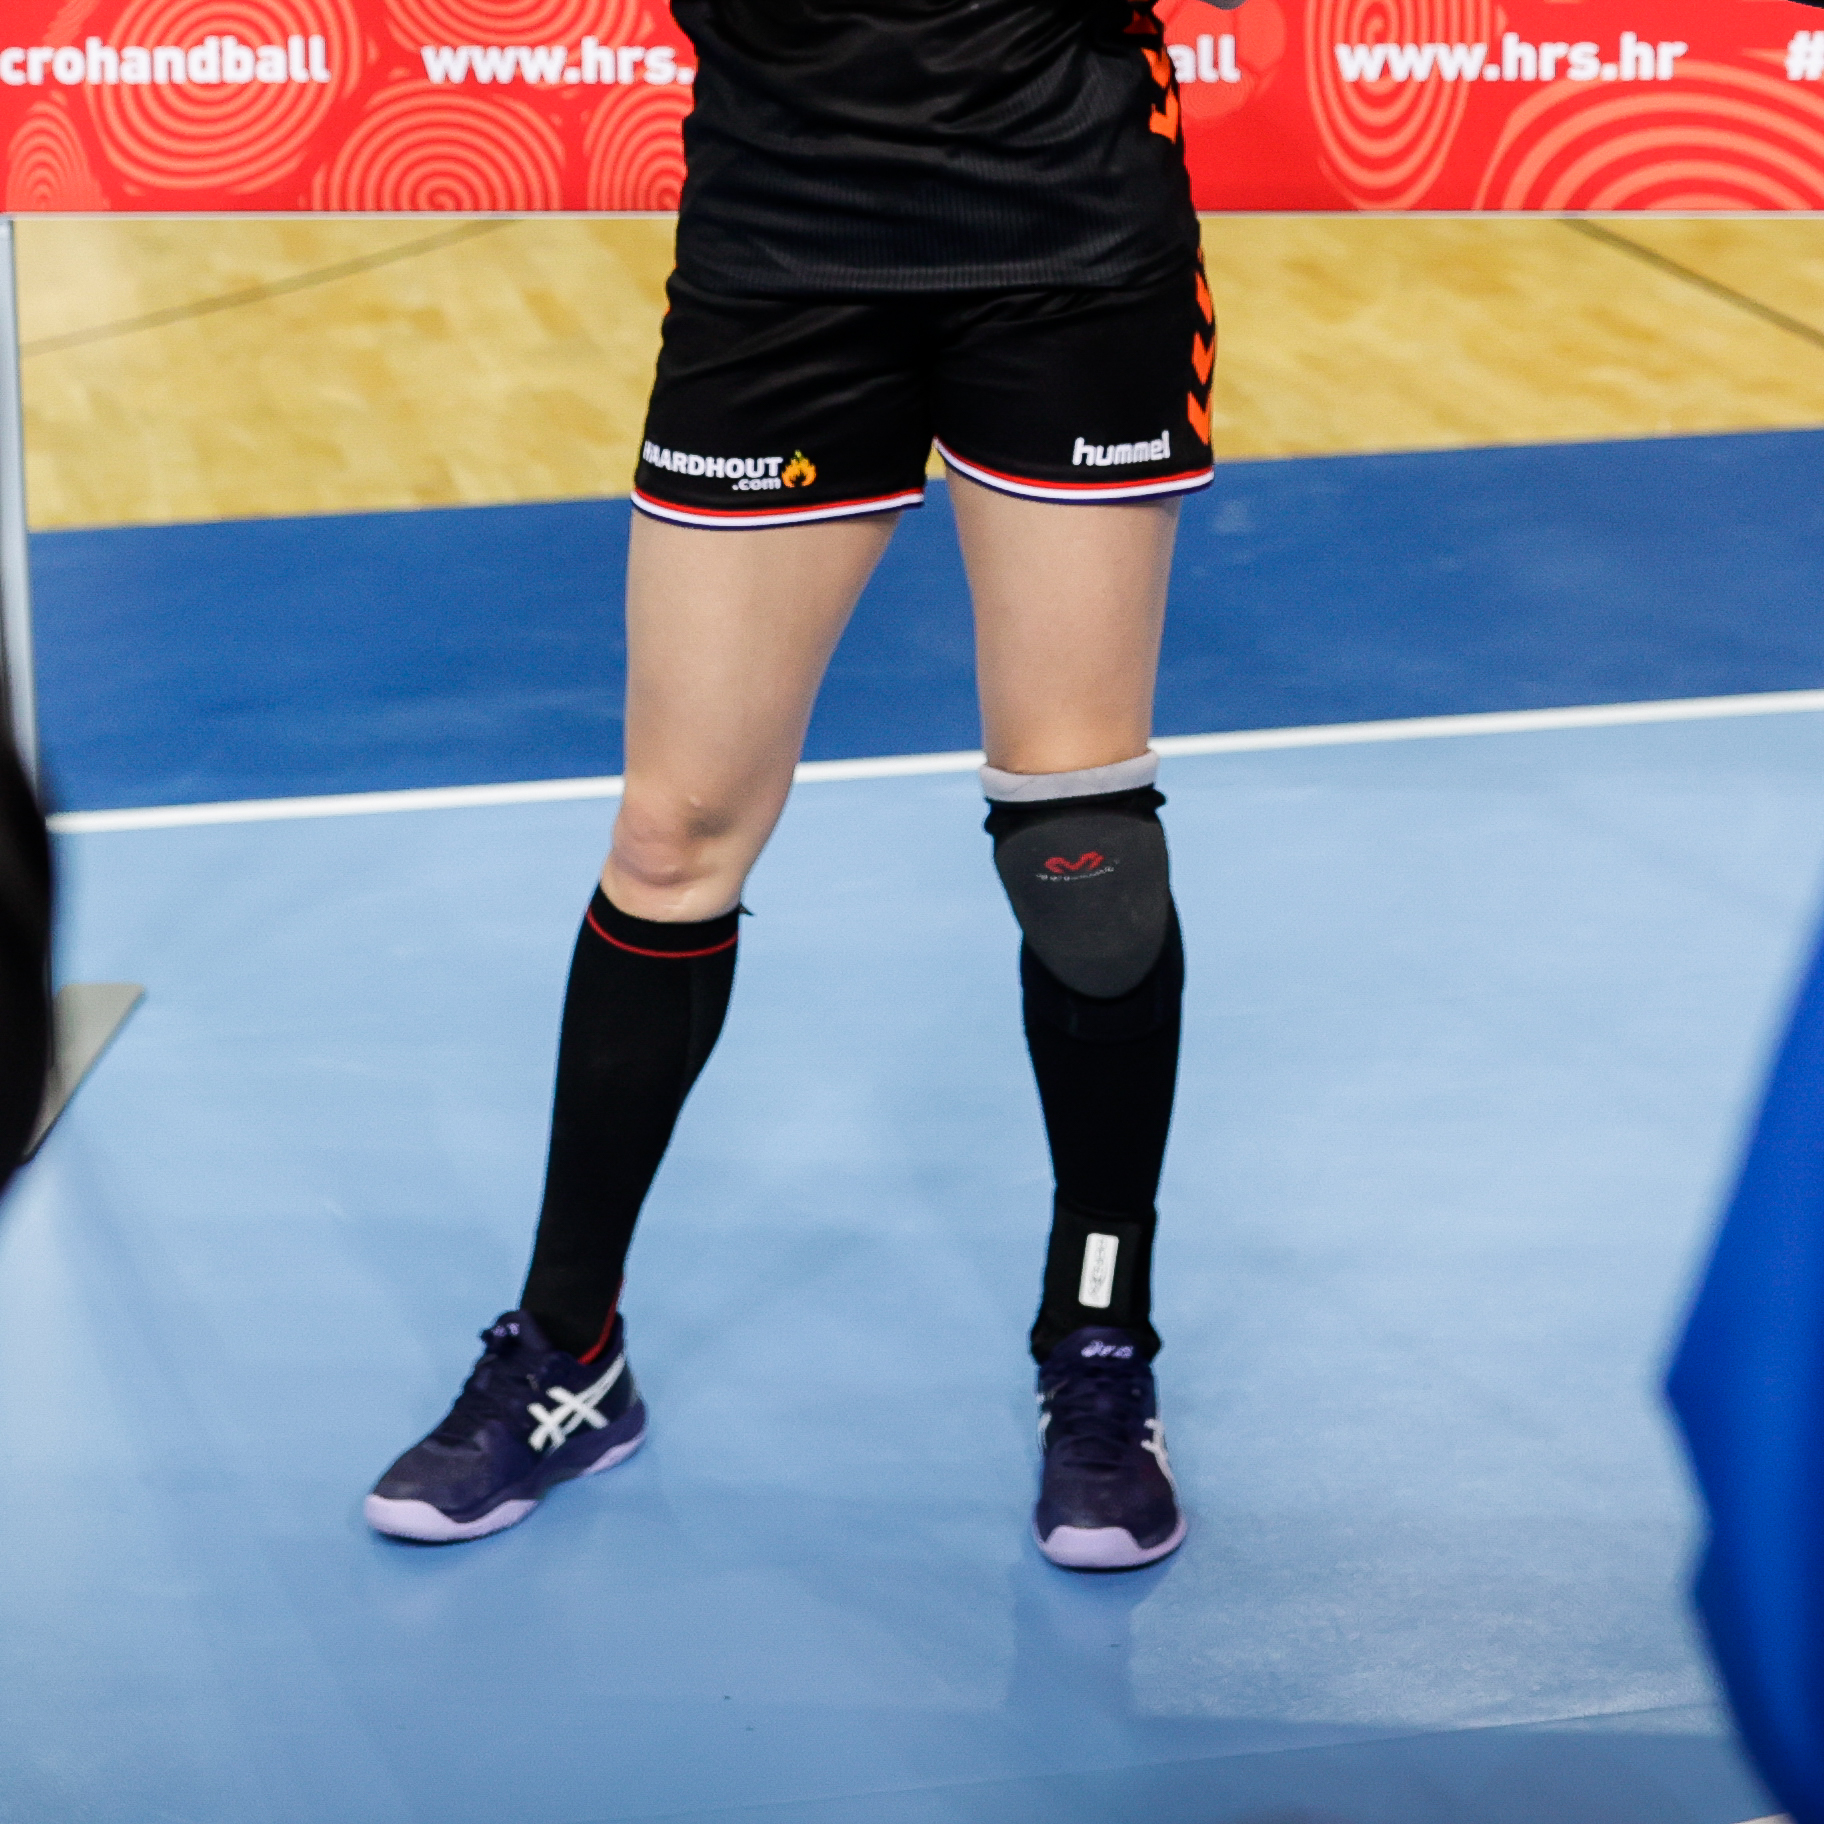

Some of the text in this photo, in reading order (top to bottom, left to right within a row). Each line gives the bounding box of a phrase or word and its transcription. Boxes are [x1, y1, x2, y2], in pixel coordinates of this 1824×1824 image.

[418, 38, 696, 84] www.hrs.
[1334, 31, 1689, 84] www.hrs.hr
[1072, 428, 1171, 467] hummel
[732, 476, 782, 492] .com
